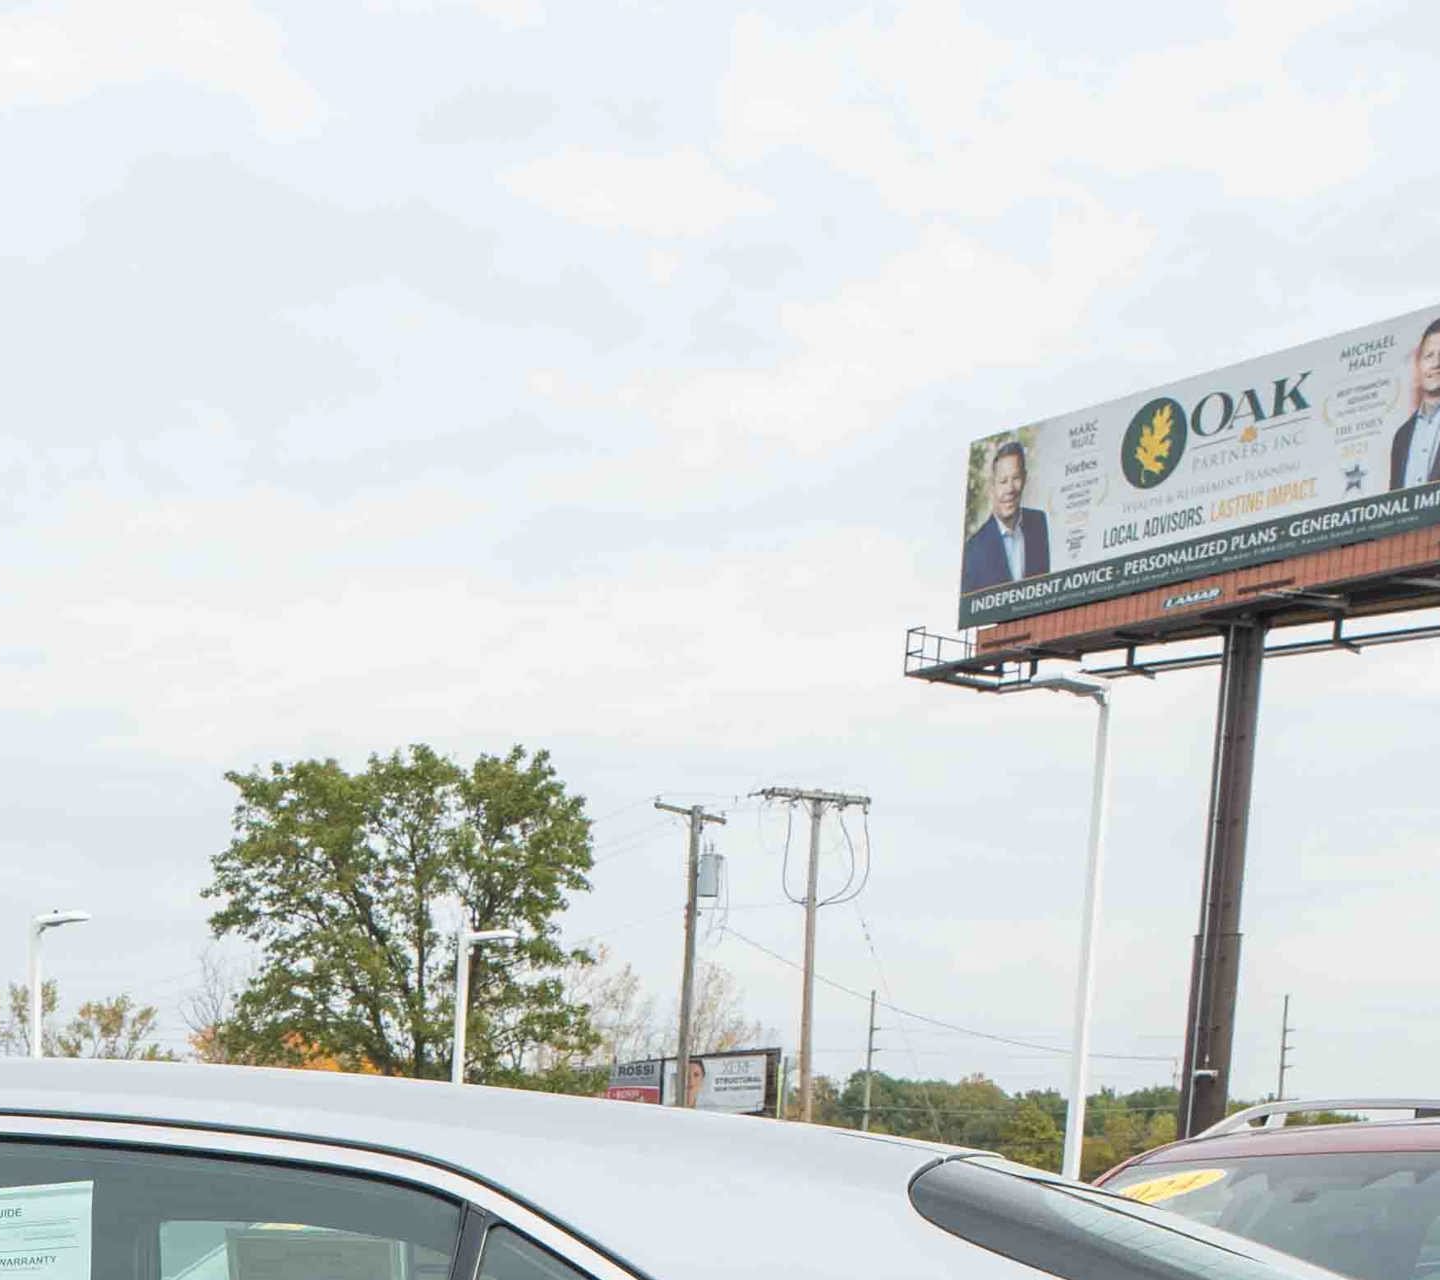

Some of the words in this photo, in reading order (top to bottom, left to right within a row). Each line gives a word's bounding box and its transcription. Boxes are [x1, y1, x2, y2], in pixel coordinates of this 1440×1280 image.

[1340, 334, 1398, 362] MICHAEL
[1348, 351, 1386, 372] HADT
[1191, 370, 1312, 437] OAK
[1069, 419, 1099, 437] MARC
[1071, 433, 1096, 449] RUIZ
[1192, 440, 1267, 473] PARTNERS
[1065, 459, 1099, 477] Forbes
[1101, 523, 1139, 550] LOCAL
[1142, 504, 1205, 539] ADVISORS.
[1210, 490, 1265, 523] LASTING
[970, 578, 1062, 615] INDEPENDENT
[1063, 566, 1113, 592] ADVICE
[1124, 540, 1224, 577] PERSONALIZED
[1225, 526, 1277, 553] PLANS
[1289, 497, 1409, 538] GENERATIONAL
[1165, 587, 1221, 609] LAMAR
[618, 1064, 654, 1077] ROSSI
